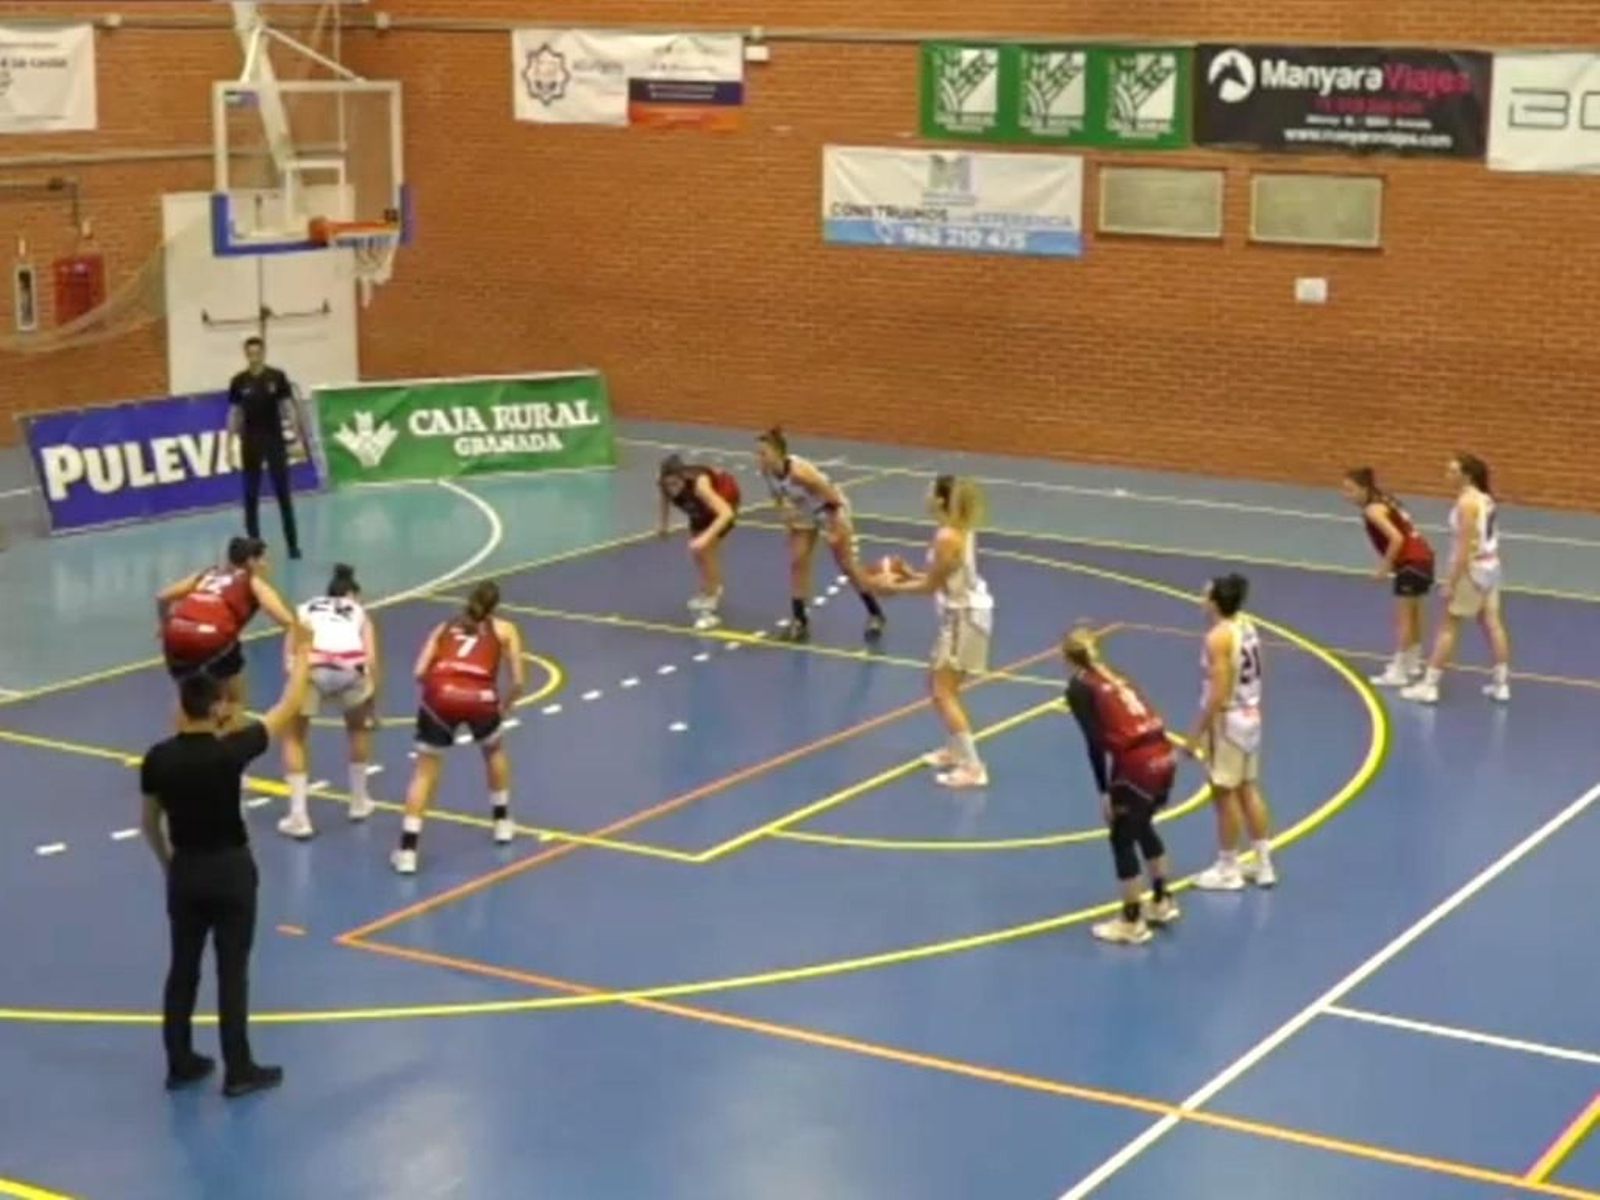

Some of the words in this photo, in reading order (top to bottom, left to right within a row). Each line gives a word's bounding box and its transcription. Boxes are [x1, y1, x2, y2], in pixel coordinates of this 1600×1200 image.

[408, 405, 488, 436] CAJA
[491, 399, 599, 431] RURAL
[454, 432, 563, 456] GRANADA
[454, 634, 478, 658] 7
